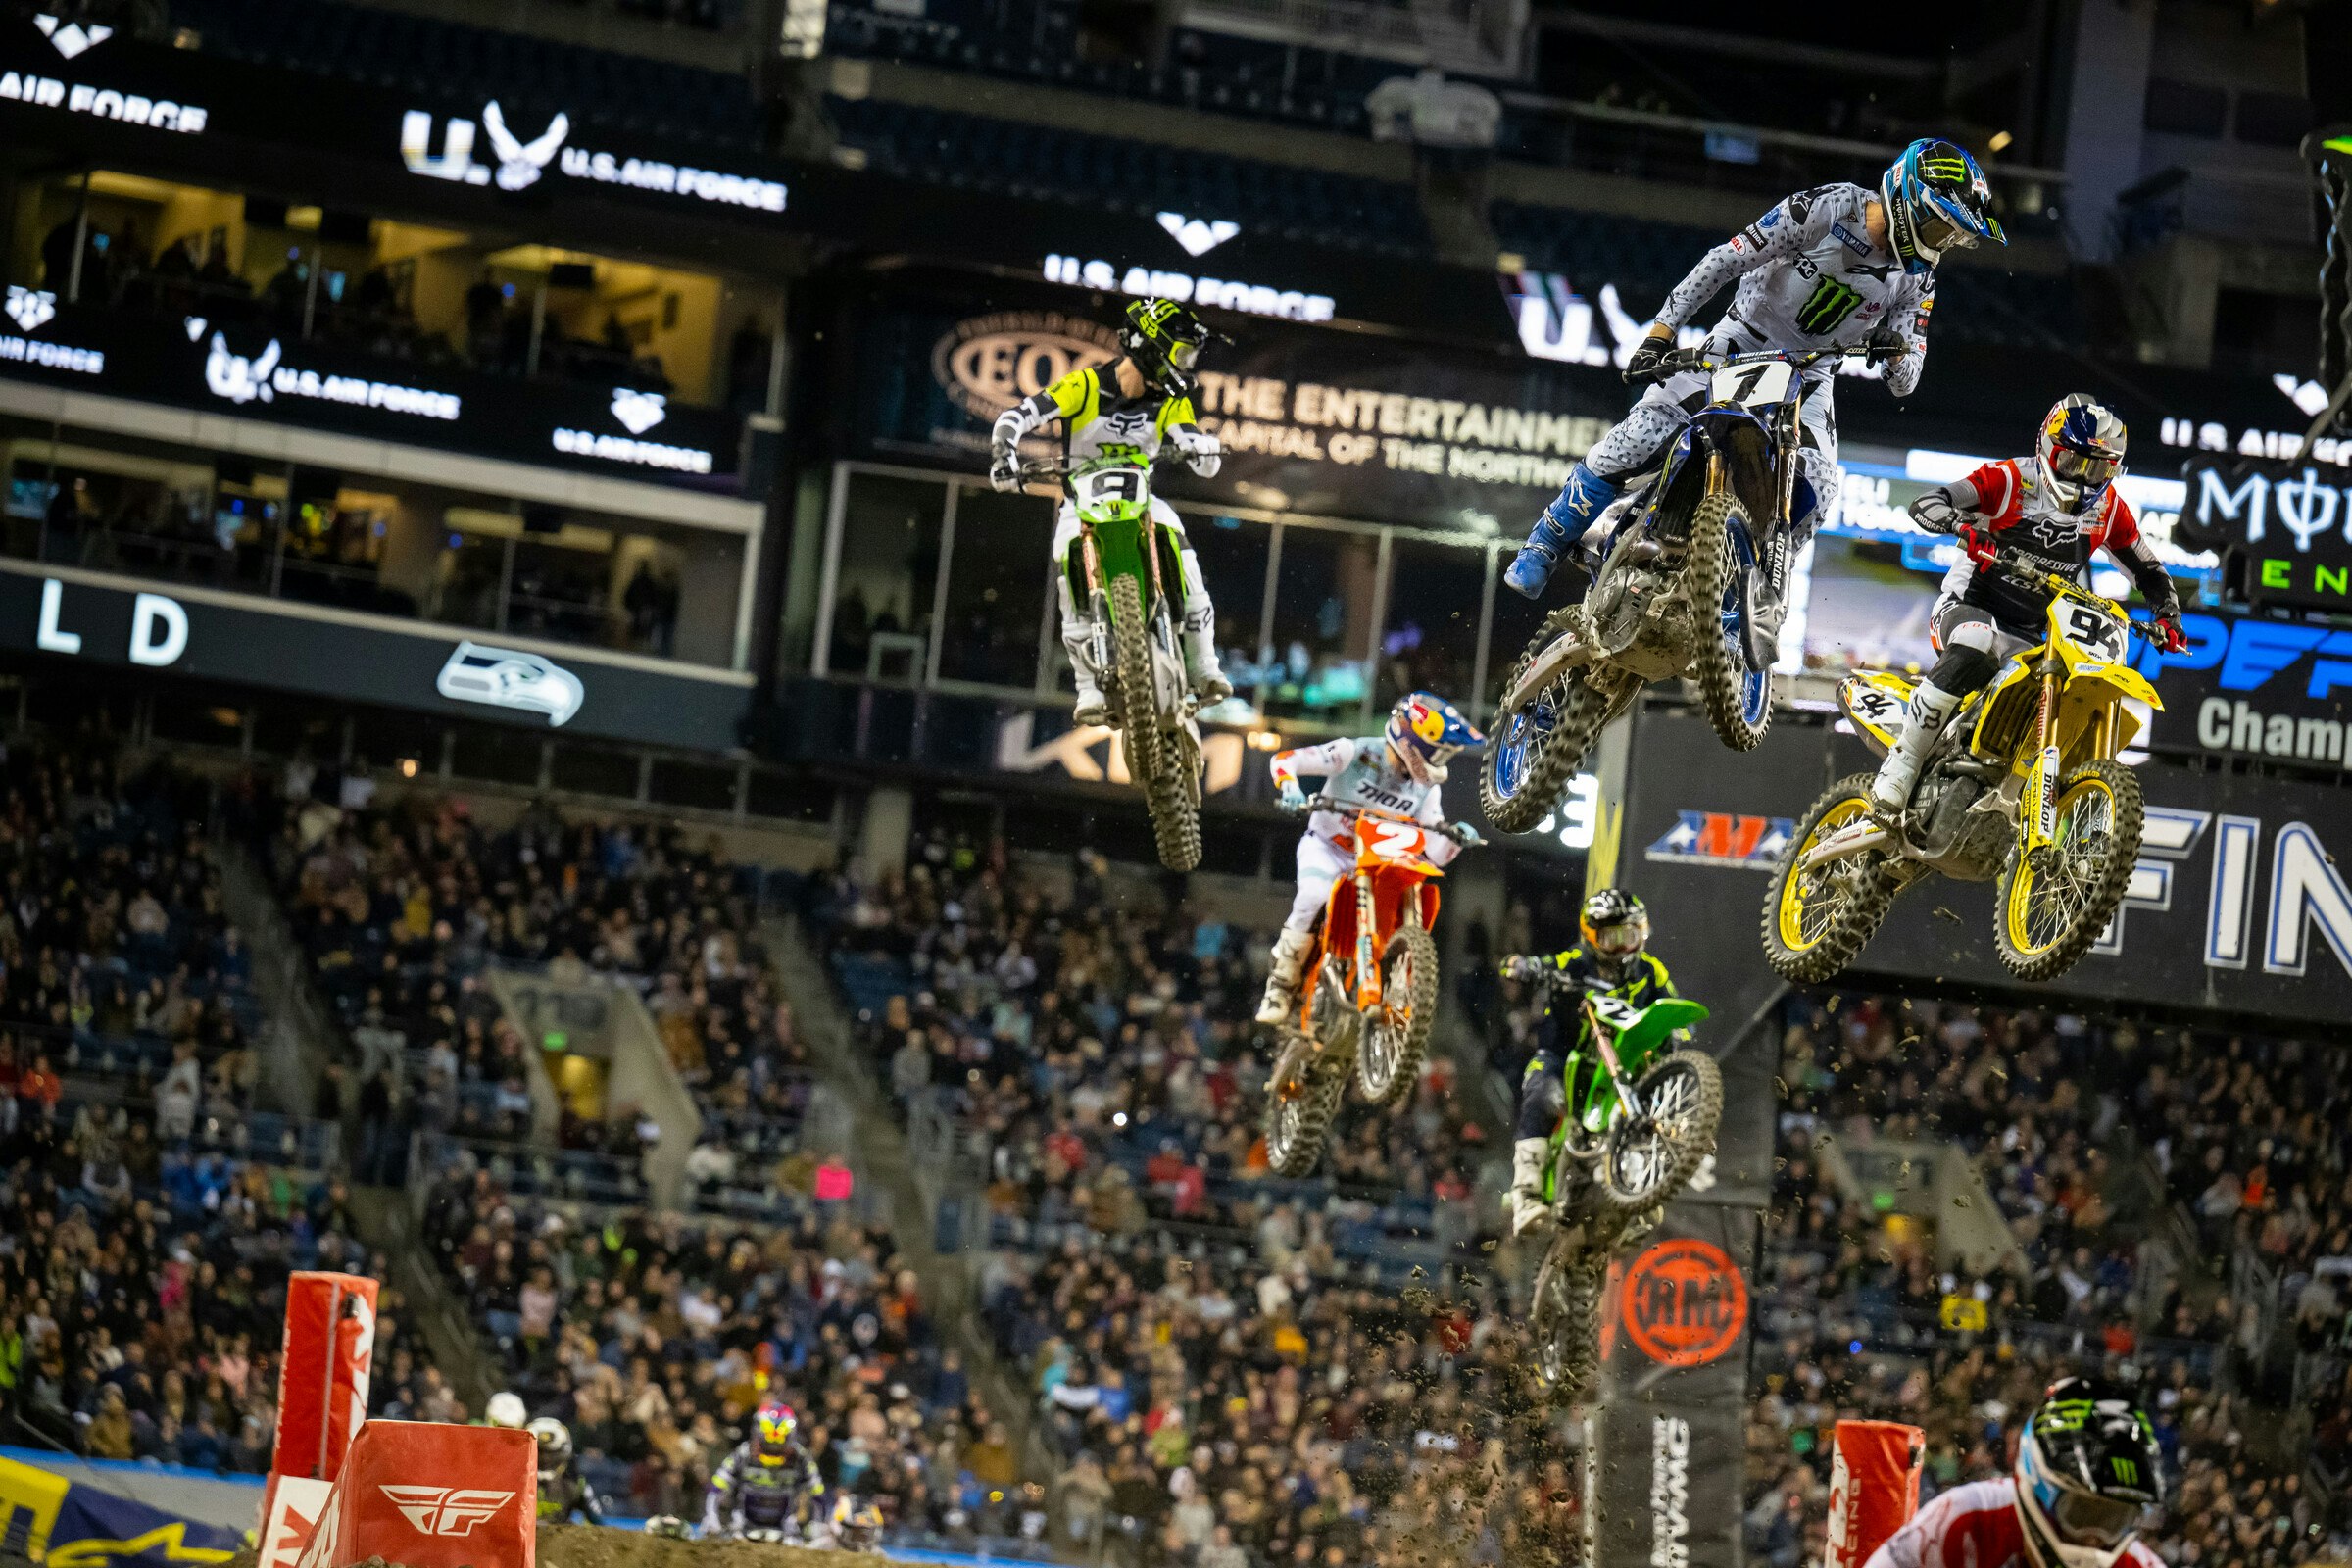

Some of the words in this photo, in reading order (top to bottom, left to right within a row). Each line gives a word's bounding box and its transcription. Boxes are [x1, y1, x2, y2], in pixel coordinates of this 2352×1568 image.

[620, 158, 675, 192] AIR
[676, 167, 787, 212] FORCE
[1841, 229, 1868, 256] YAMAHA
[1195, 277, 1336, 322] FORCE
[1199, 370, 1288, 421] THE
[1328, 431, 1379, 466] OF
[1382, 437, 1446, 476] THE
[1771, 531, 1786, 591] DUNLOP
[2065, 608, 2120, 661] 94
[2197, 695, 2352, 772] Cham
[1358, 781, 1414, 812] THOR
[2040, 772, 2053, 834] DUNLOP
[1370, 822, 1419, 858] 2
